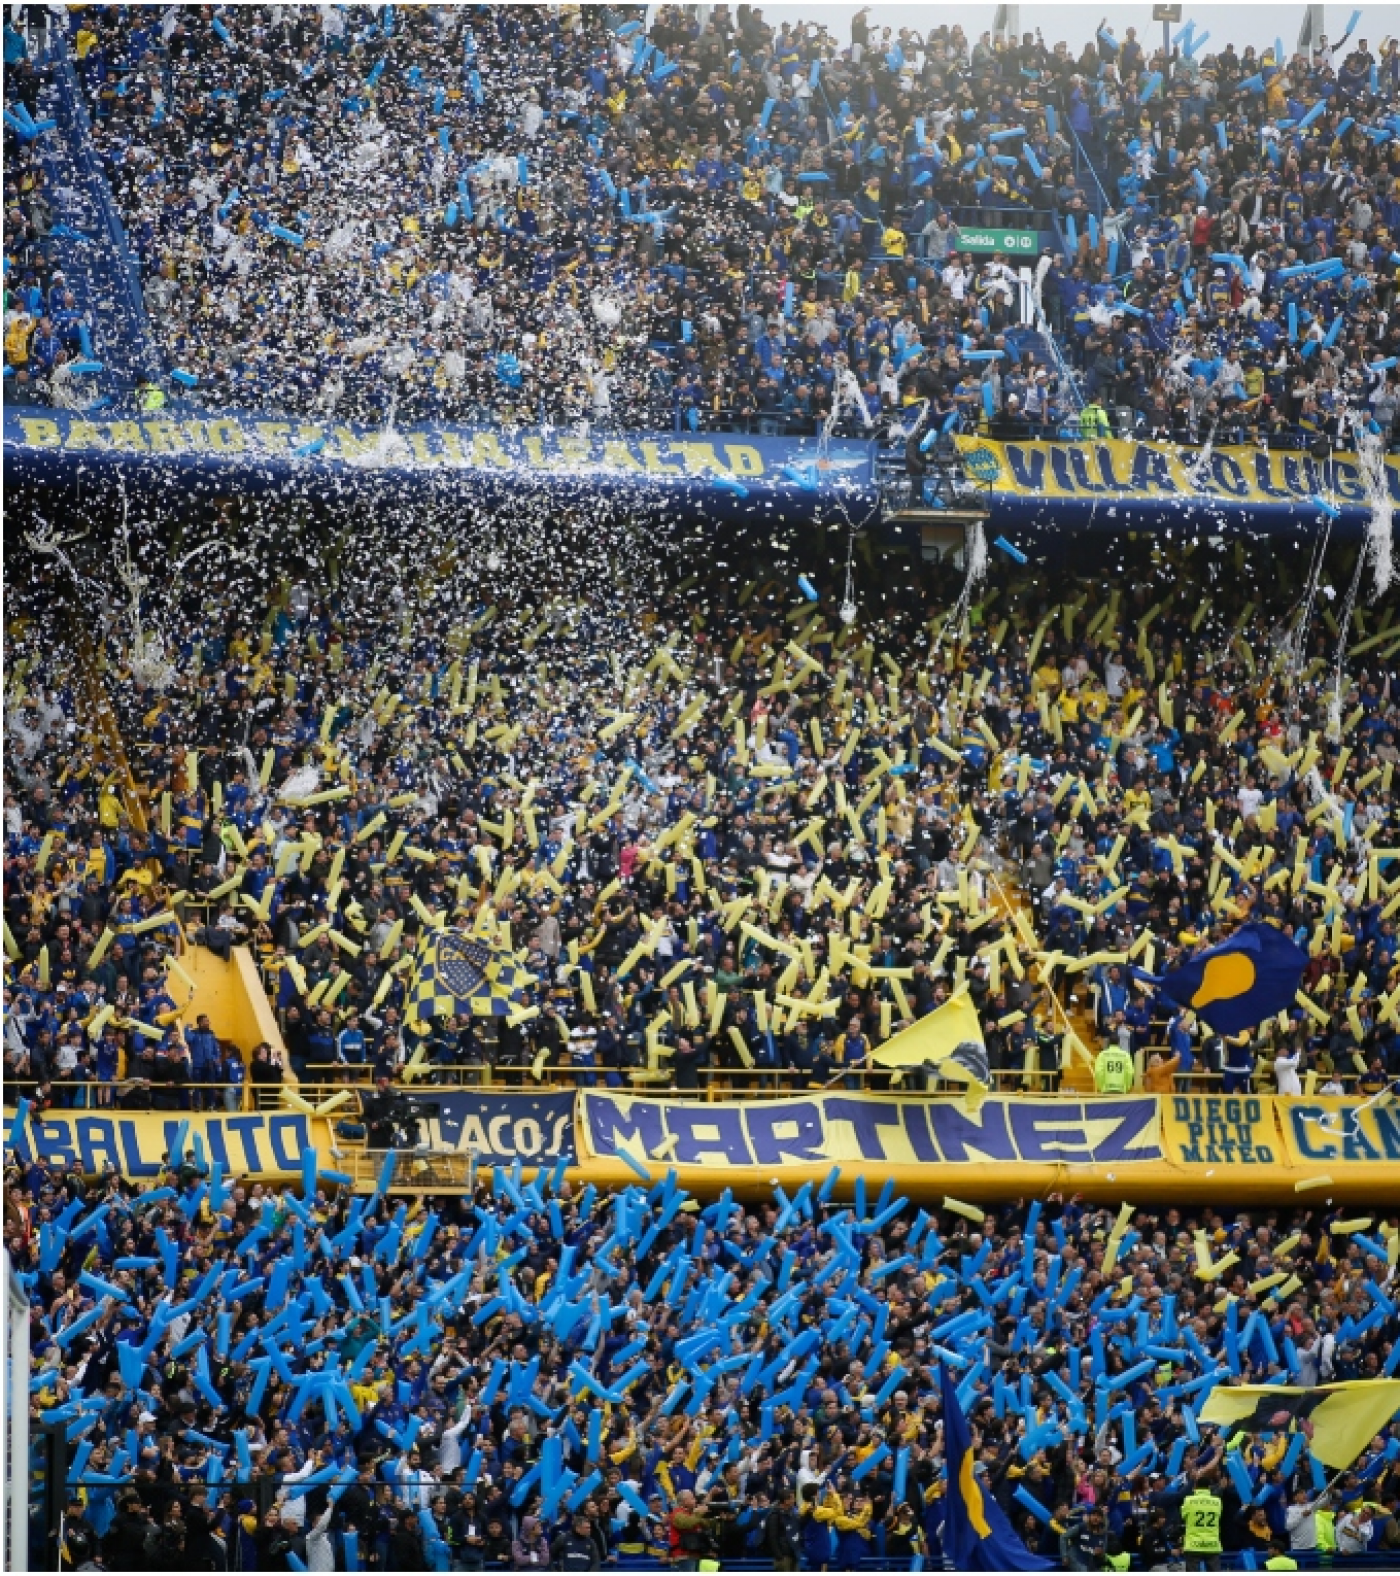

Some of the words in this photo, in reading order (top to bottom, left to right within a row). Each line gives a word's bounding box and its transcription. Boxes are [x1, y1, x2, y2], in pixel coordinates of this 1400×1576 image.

[960, 233, 995, 247] Salida
[1006, 444, 1177, 494] VILLA
[1106, 1060, 1123, 1074] 69
[1174, 1097, 1262, 1123] DIEGO
[584, 1095, 1164, 1164] MARTINEZ
[1188, 1122, 1253, 1145] PILU
[1180, 1144, 1275, 1163] MATEO
[1193, 1510, 1216, 1528] 22
